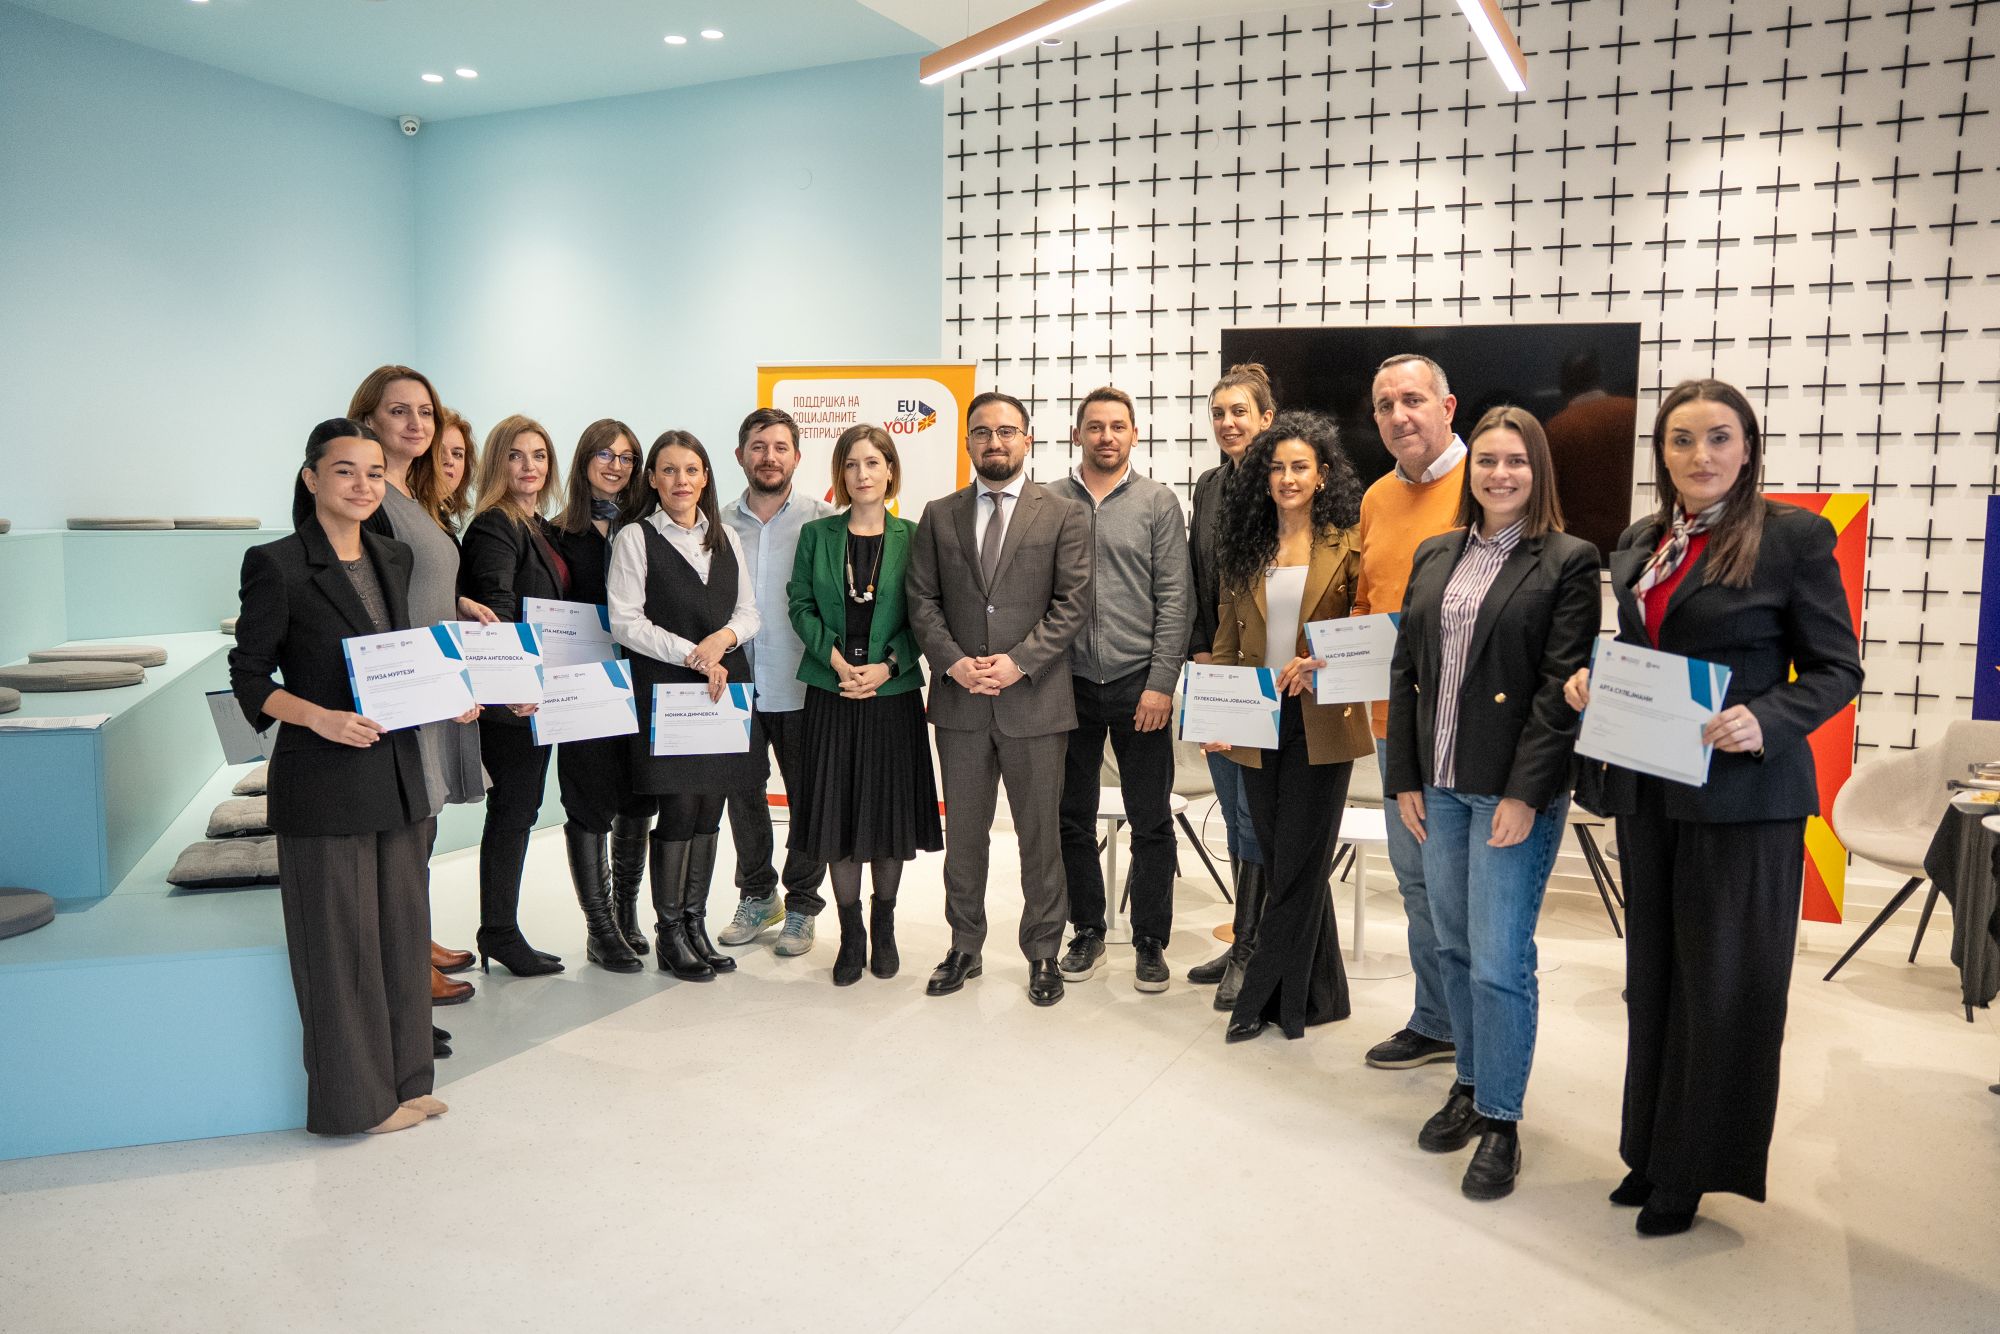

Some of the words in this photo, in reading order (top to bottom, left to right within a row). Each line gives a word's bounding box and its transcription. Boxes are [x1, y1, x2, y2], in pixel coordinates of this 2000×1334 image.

[793, 396, 845, 408] ПОДДРШКА
[848, 395, 860, 407] НА
[898, 400, 915, 413] EU
[793, 411, 857, 424] СОЦИЈАЛНИТЕ
[894, 412, 919, 422] with
[884, 421, 914, 434] YOU
[387, 668, 415, 678] МУРТЕЗИ
